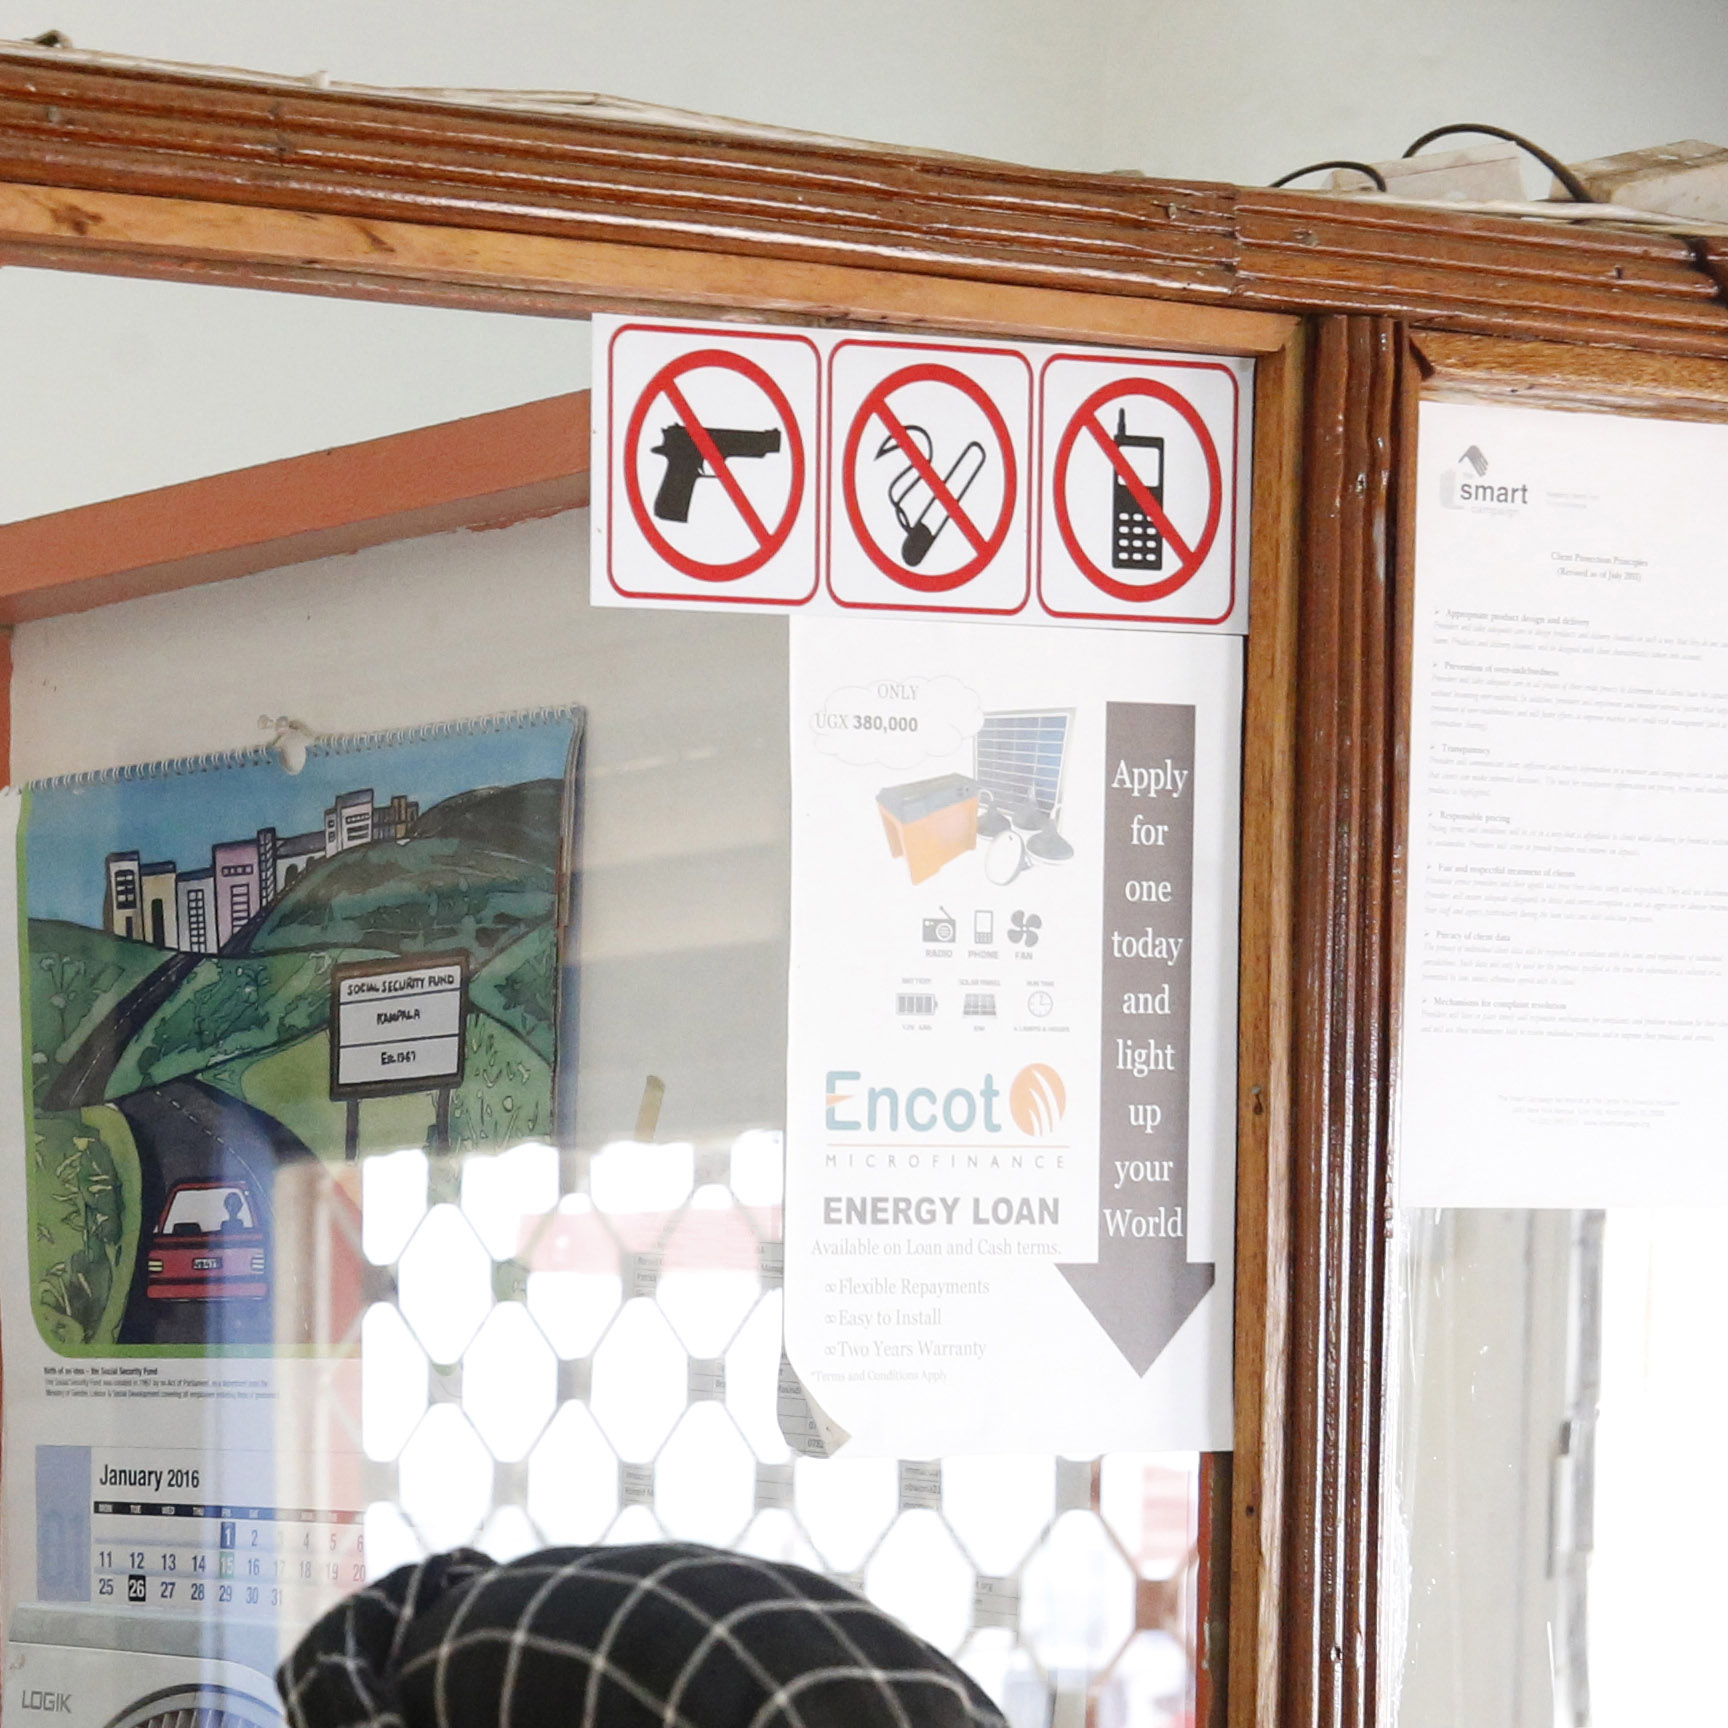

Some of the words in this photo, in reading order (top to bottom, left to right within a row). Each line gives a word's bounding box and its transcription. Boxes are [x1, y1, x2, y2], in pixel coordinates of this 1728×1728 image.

[1460, 482, 1528, 505] smart
[878, 683, 919, 700] ONLY
[816, 713, 849, 729] UGX
[853, 715, 919, 734] 380,000
[1112, 760, 1188, 798] Apply
[1130, 816, 1169, 848] for
[1125, 875, 1172, 903] one
[925, 949, 953, 958] RADIO
[968, 950, 998, 960] PHONE
[1015, 951, 1033, 960] FAN
[1111, 930, 1183, 965] today
[347, 984, 380, 996] SOCIAL
[382, 977, 425, 993] SECURITY
[428, 974, 455, 987] FUND
[1122, 986, 1171, 1016] and
[1116, 1040, 1176, 1078] light
[826, 1071, 1002, 1132] Encot
[1129, 1101, 1162, 1136] up
[826, 1154, 1064, 1168] MICROFINANCE
[1114, 1160, 1173, 1191] your
[824, 1197, 960, 1225] ENERGY
[973, 1197, 1059, 1225] LOAN
[1103, 1206, 1184, 1240] World
[811, 1239, 879, 1256] Available
[883, 1243, 901, 1256] on
[906, 1240, 942, 1256] Loan
[947, 1240, 973, 1256] and
[977, 1240, 1012, 1256] Cash
[1017, 1241, 1062, 1256] terms.
[901, 1279, 990, 1298] Repayments
[877, 1311, 892, 1325] to
[896, 1308, 942, 1325] Install
[873, 1341, 913, 1357] Years
[917, 1341, 986, 1360] Warranty
[100, 1464, 163, 1491] January
[167, 1469, 200, 1488] 2016
[225, 1527, 233, 1546] 1
[251, 1530, 258, 1547] 2
[303, 1533, 310, 1549] 4
[330, 1535, 337, 1551] 5
[356, 1536, 364, 1552] 6
[100, 1551, 112, 1568] 11
[130, 1552, 145, 1569] 12
[161, 1554, 176, 1571] 13
[191, 1555, 205, 1573] 14
[220, 1557, 234, 1575] 15
[247, 1559, 260, 1576] 16
[299, 1562, 312, 1579] 18
[326, 1563, 339, 1581] 19
[353, 1565, 366, 1582] 20
[99, 1578, 114, 1595] 25
[129, 1581, 145, 1597] 26
[161, 1582, 176, 1599] 27
[191, 1584, 205, 1601] 28
[218, 1585, 233, 1602] 29
[246, 1587, 259, 1605] 30
[271, 1589, 283, 1606] 31
[22, 1690, 72, 1713] LOGIK
